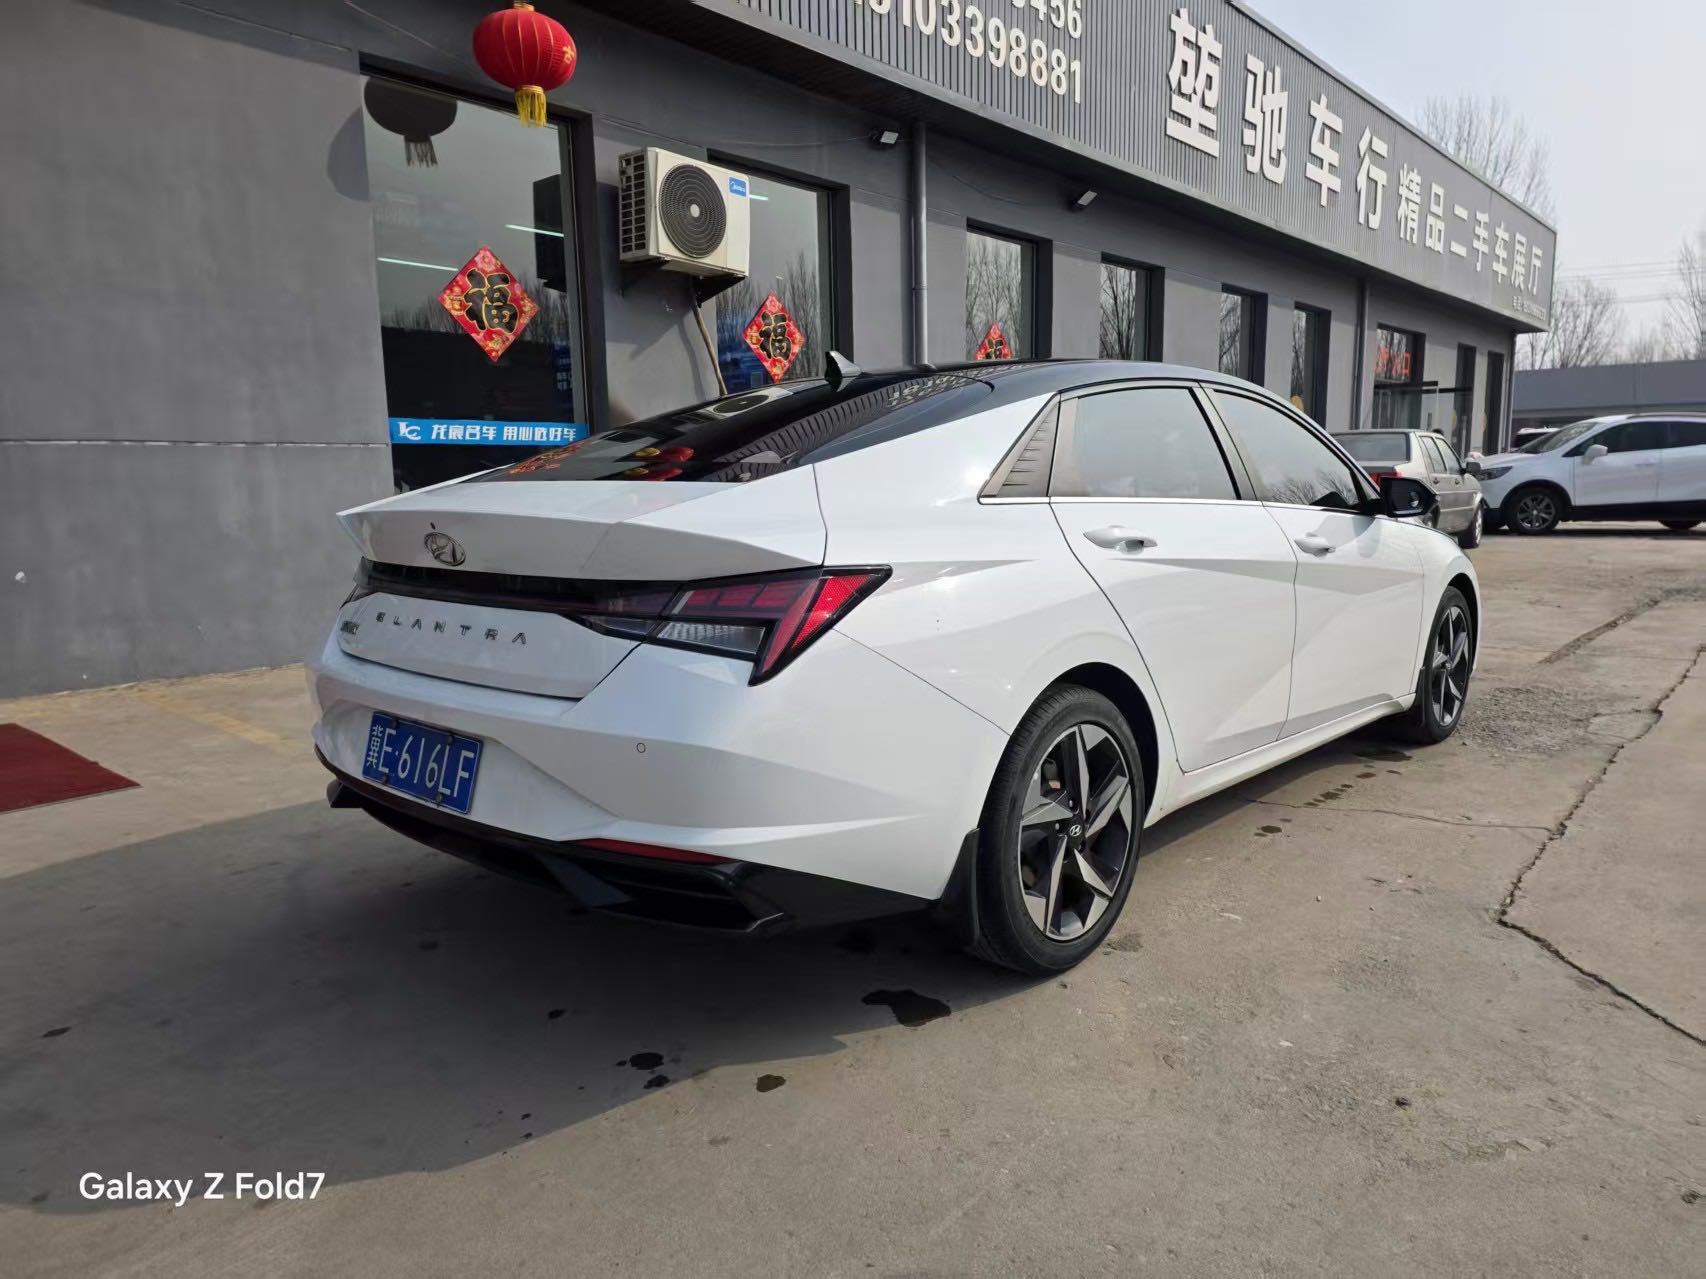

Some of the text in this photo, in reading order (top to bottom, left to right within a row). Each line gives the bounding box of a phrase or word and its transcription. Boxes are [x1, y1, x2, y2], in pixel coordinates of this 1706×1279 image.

[1010, 0, 1082, 39] 56
[854, 0, 1081, 104] 03398881
[1398, 162, 1543, 296] 精品二手车展厅
[463, 268, 520, 335] 福
[758, 310, 793, 364] 福
[376, 611, 527, 645] ELANTRA
